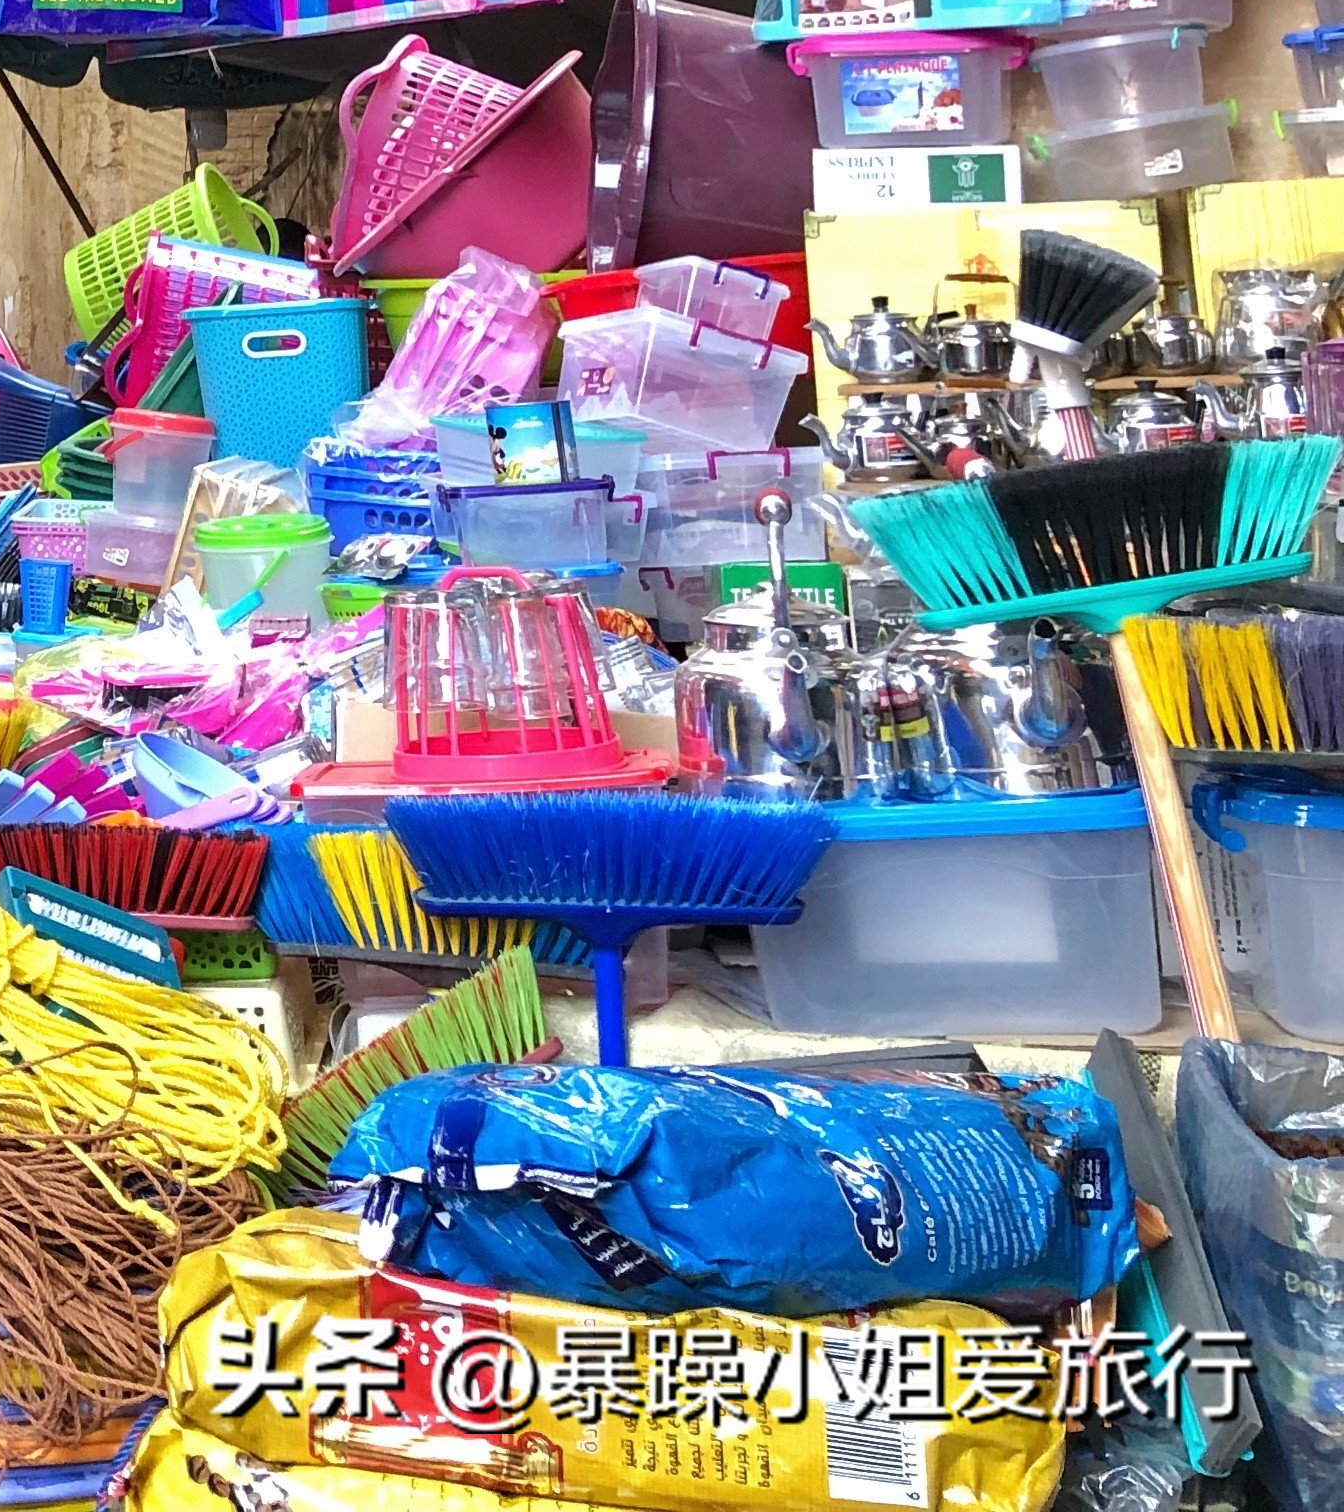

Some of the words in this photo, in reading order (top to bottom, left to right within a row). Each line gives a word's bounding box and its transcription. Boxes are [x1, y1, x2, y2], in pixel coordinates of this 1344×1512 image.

[828, 155, 895, 168] EXPRESS
[876, 184, 896, 198] 12
[1080, 1183, 1095, 1199] 5
[924, 1217, 937, 1263] Café
[905, 1491, 920, 1501] 6
